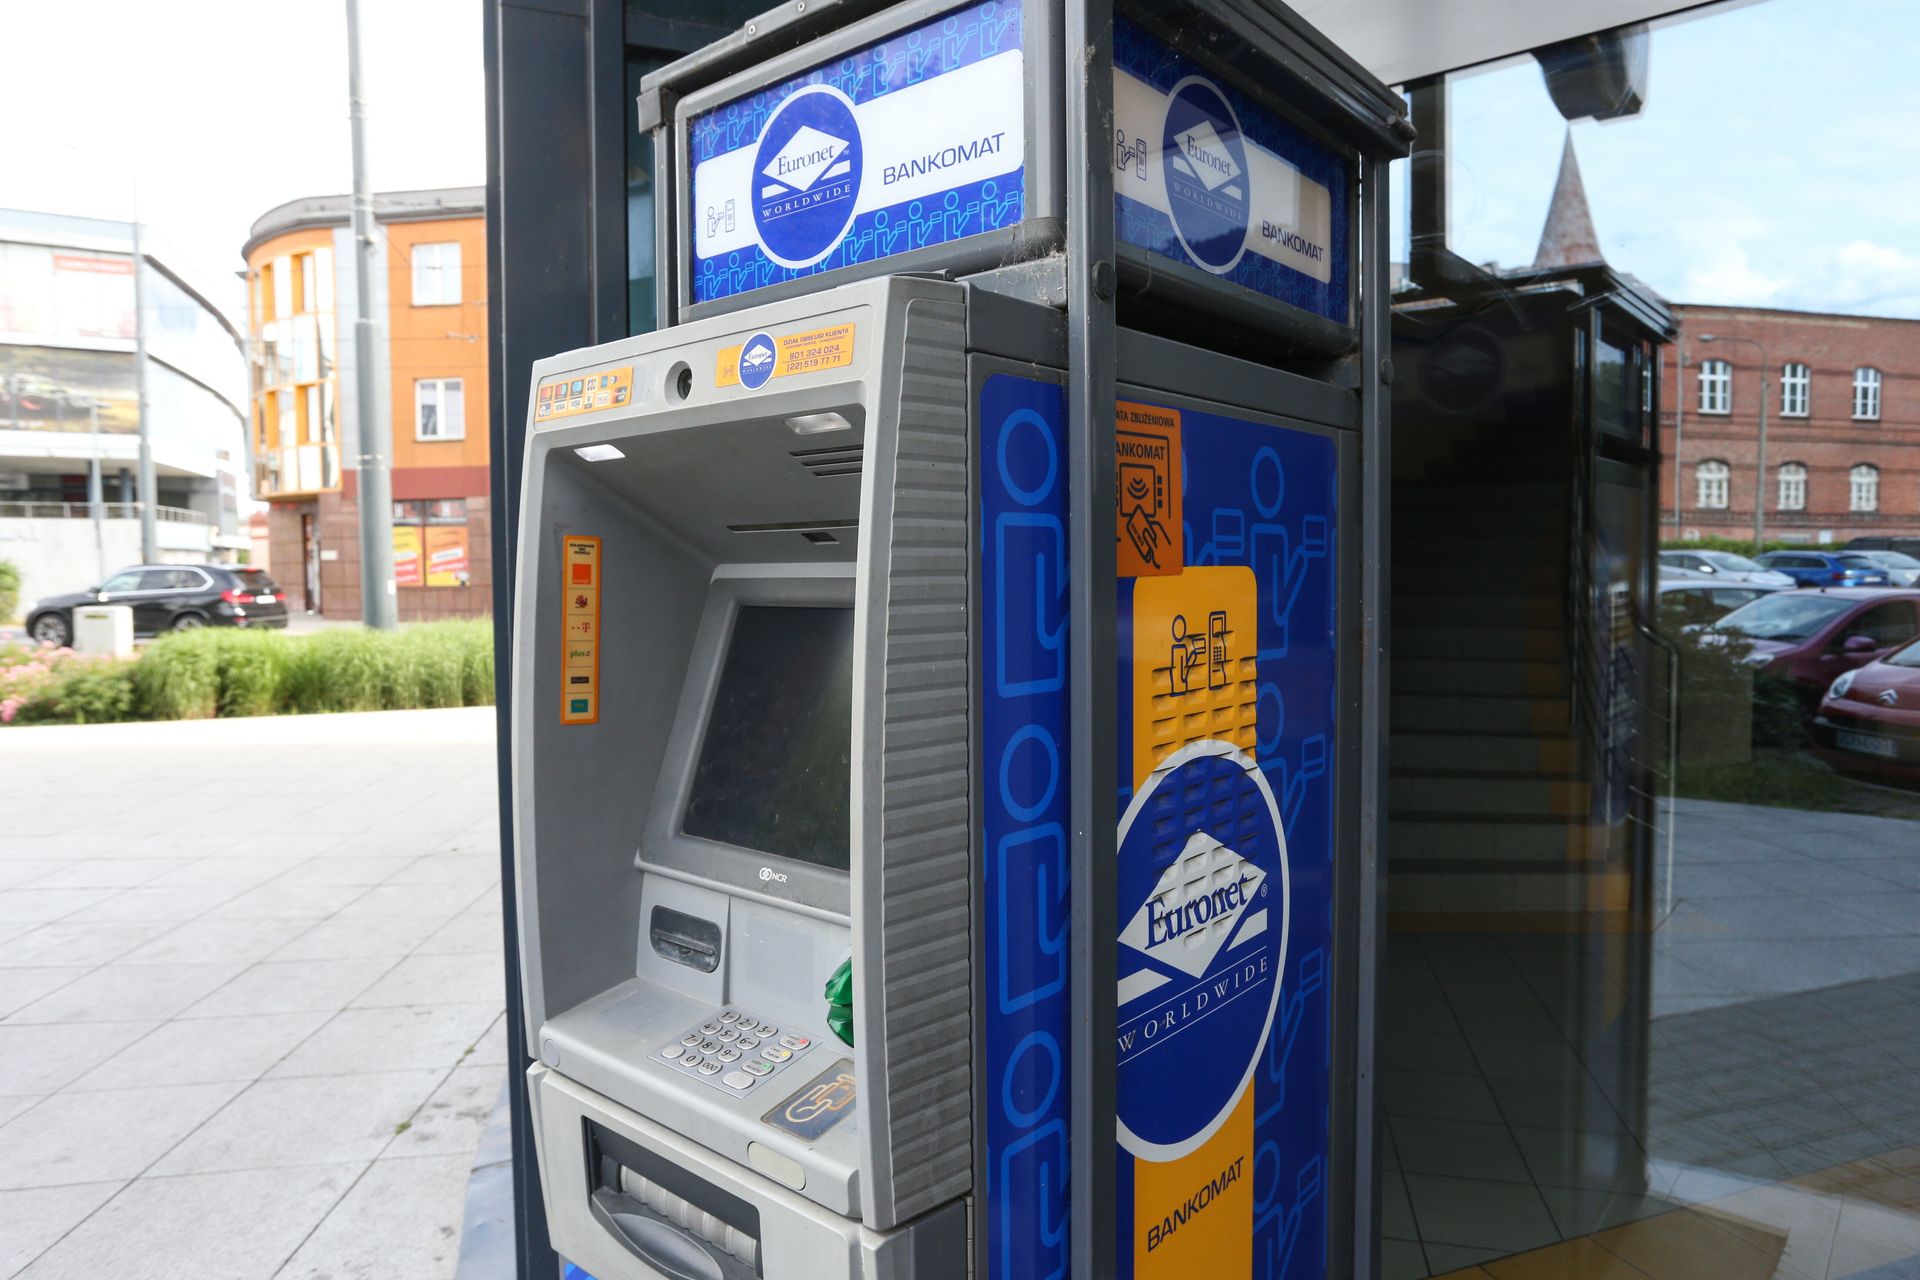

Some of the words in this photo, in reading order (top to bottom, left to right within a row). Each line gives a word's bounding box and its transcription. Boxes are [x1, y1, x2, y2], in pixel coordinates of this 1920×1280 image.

[776, 145, 834, 177] Euronet
[883, 132, 1005, 186] BANKOMAT
[1186, 134, 1232, 177] Euronet
[762, 183, 851, 218] WORLDWIDE
[1262, 220, 1324, 262] BANKOMAT
[786, 361, 803, 373] (22)
[804, 358, 818, 367] 519
[820, 356, 830, 365] 77
[833, 355, 841, 363] 71
[789, 351, 804, 360] 801
[806, 347, 821, 356] 324
[823, 344, 840, 353] 024
[1130, 411, 1175, 428] ZBLIŻENIOWA
[1116, 441, 1166, 461] ANKOMAT
[772, 872, 788, 883] NCR
[1144, 873, 1249, 950] Euronet
[1117, 956, 1268, 1053] WORLDWIDE
[1147, 1155, 1244, 1253] BANKOMAT
